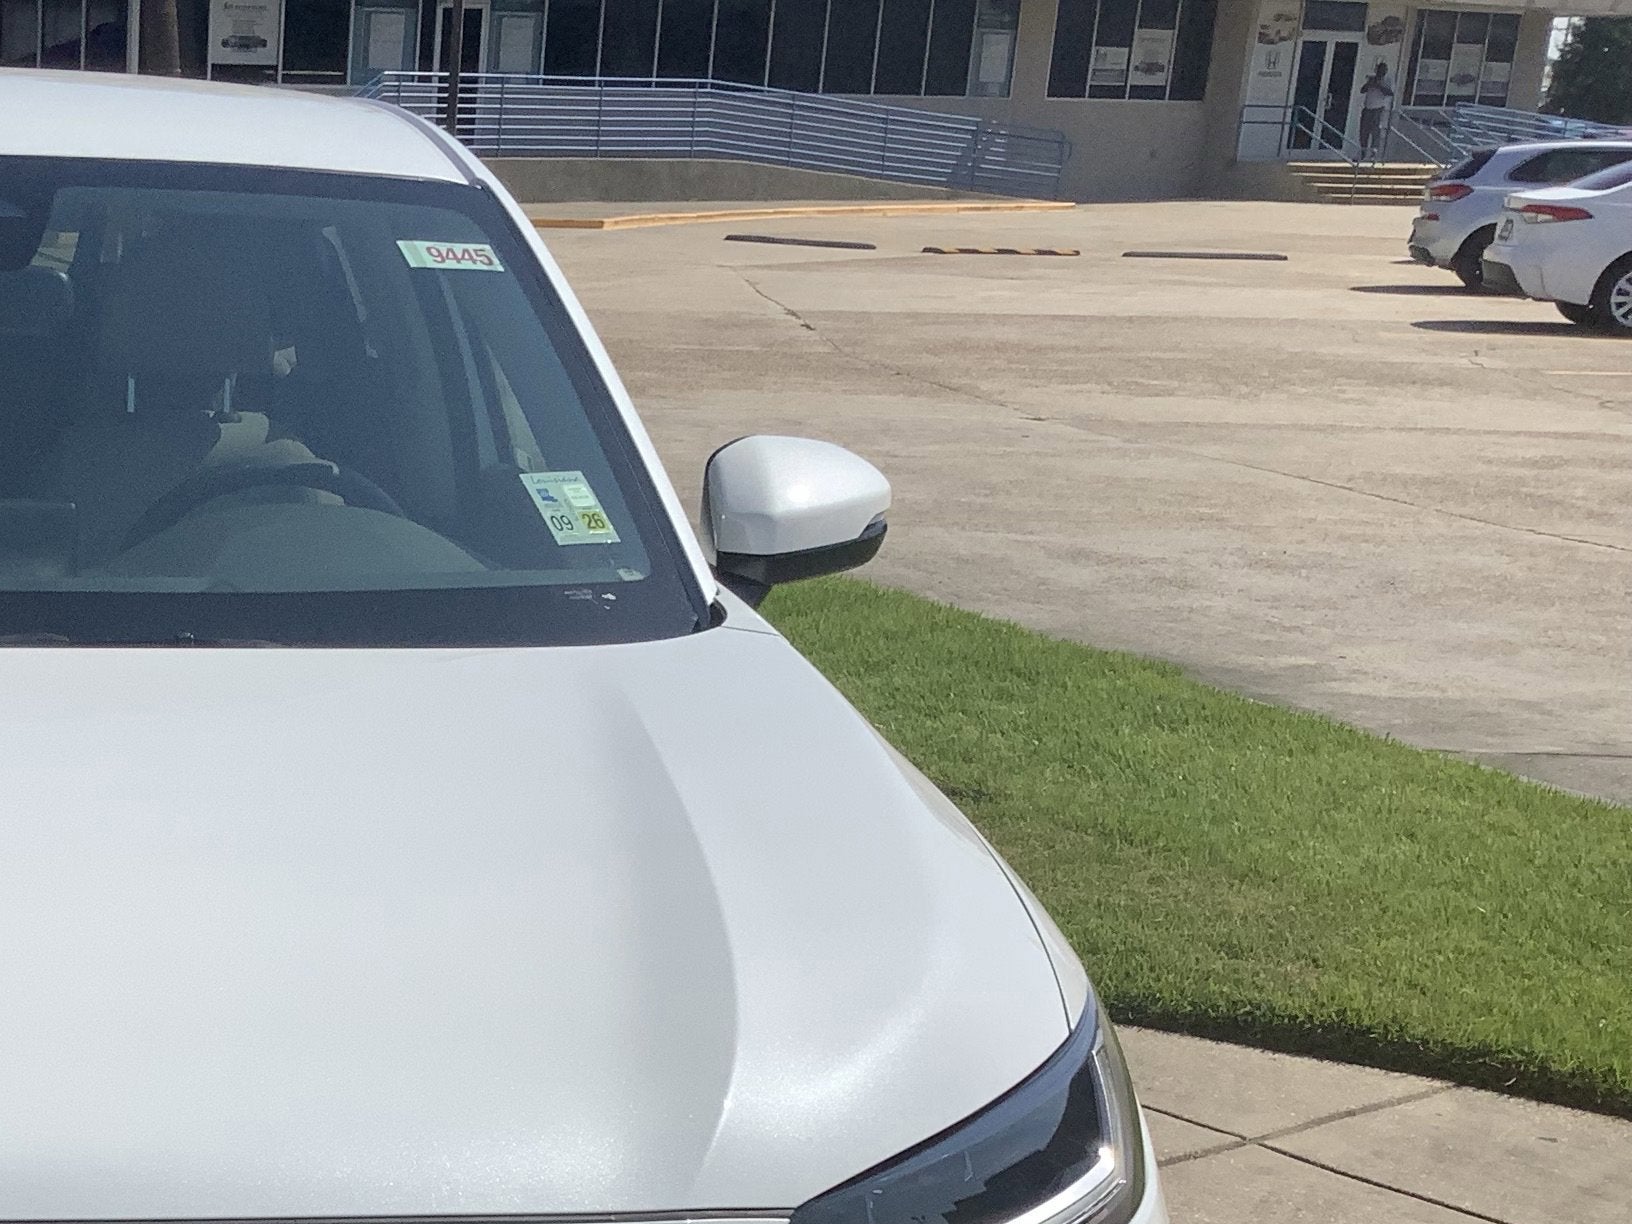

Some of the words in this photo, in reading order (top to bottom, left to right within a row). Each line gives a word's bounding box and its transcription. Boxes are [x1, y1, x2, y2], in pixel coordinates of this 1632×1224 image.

[426, 246, 494, 266] 9445
[550, 514, 574, 532] 09
[582, 512, 606, 529] 26
